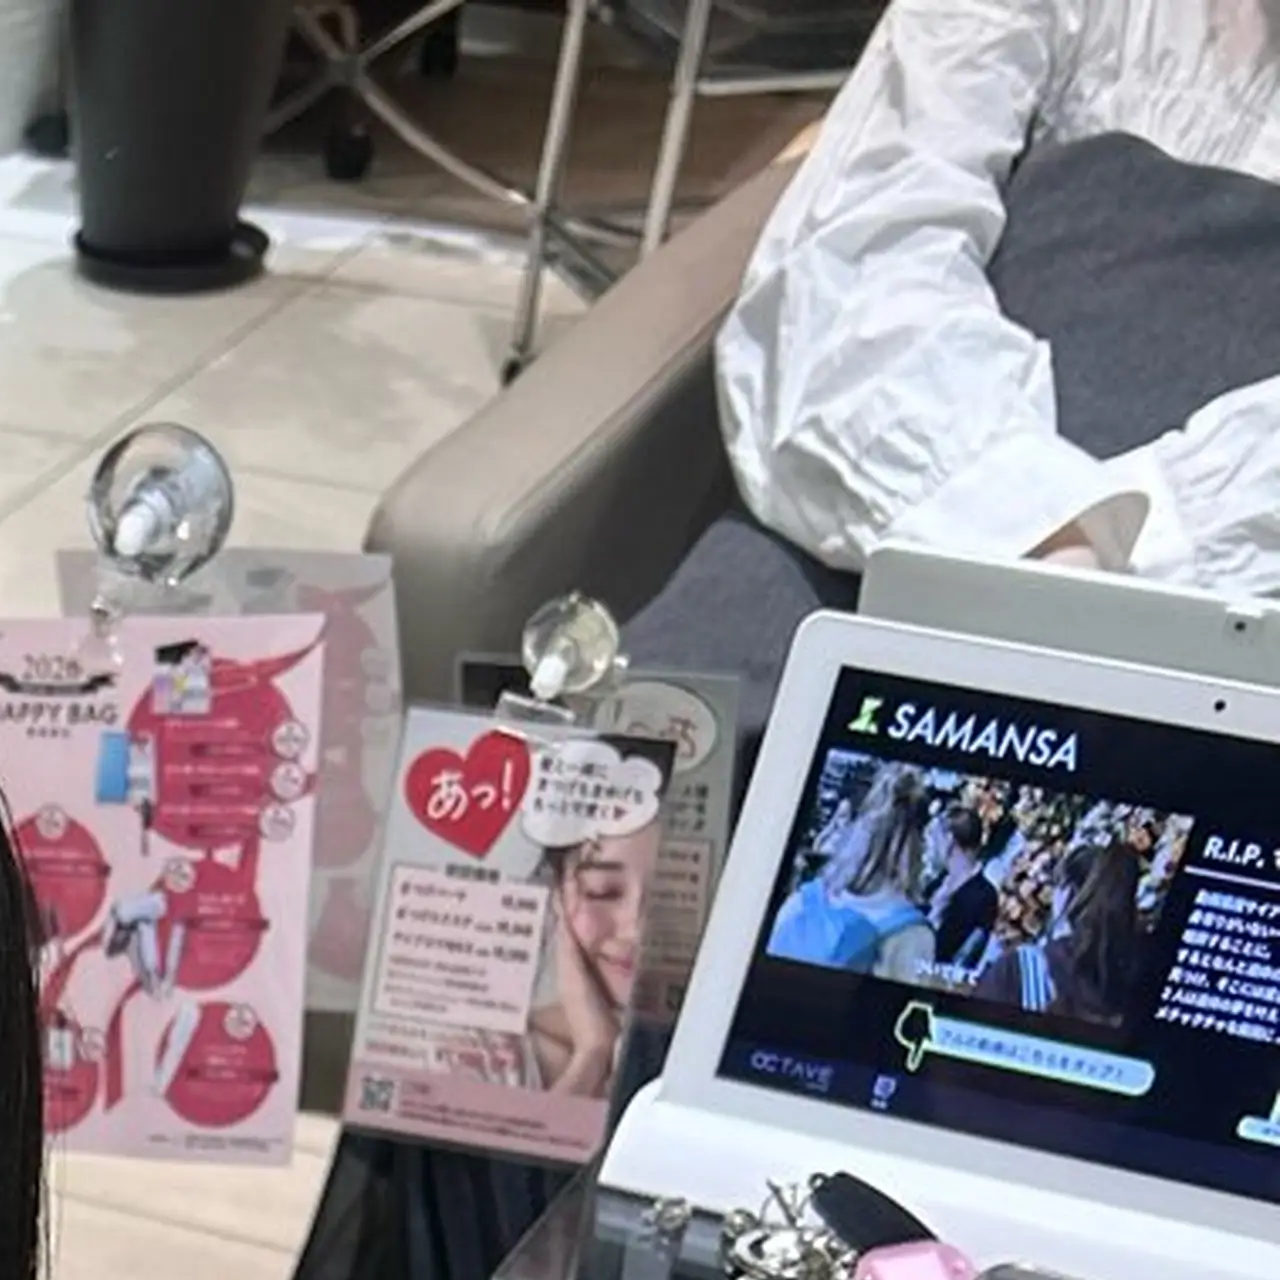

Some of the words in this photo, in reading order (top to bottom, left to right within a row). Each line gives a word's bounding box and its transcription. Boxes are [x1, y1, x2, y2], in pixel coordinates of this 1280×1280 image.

[67, 702, 117, 725] BAG
[887, 702, 1078, 773] SAMANSA
[426, 758, 513, 822] あっ!
[1203, 835, 1265, 869] R.I.P.
[750, 1051, 833, 1080] OCTAVE
